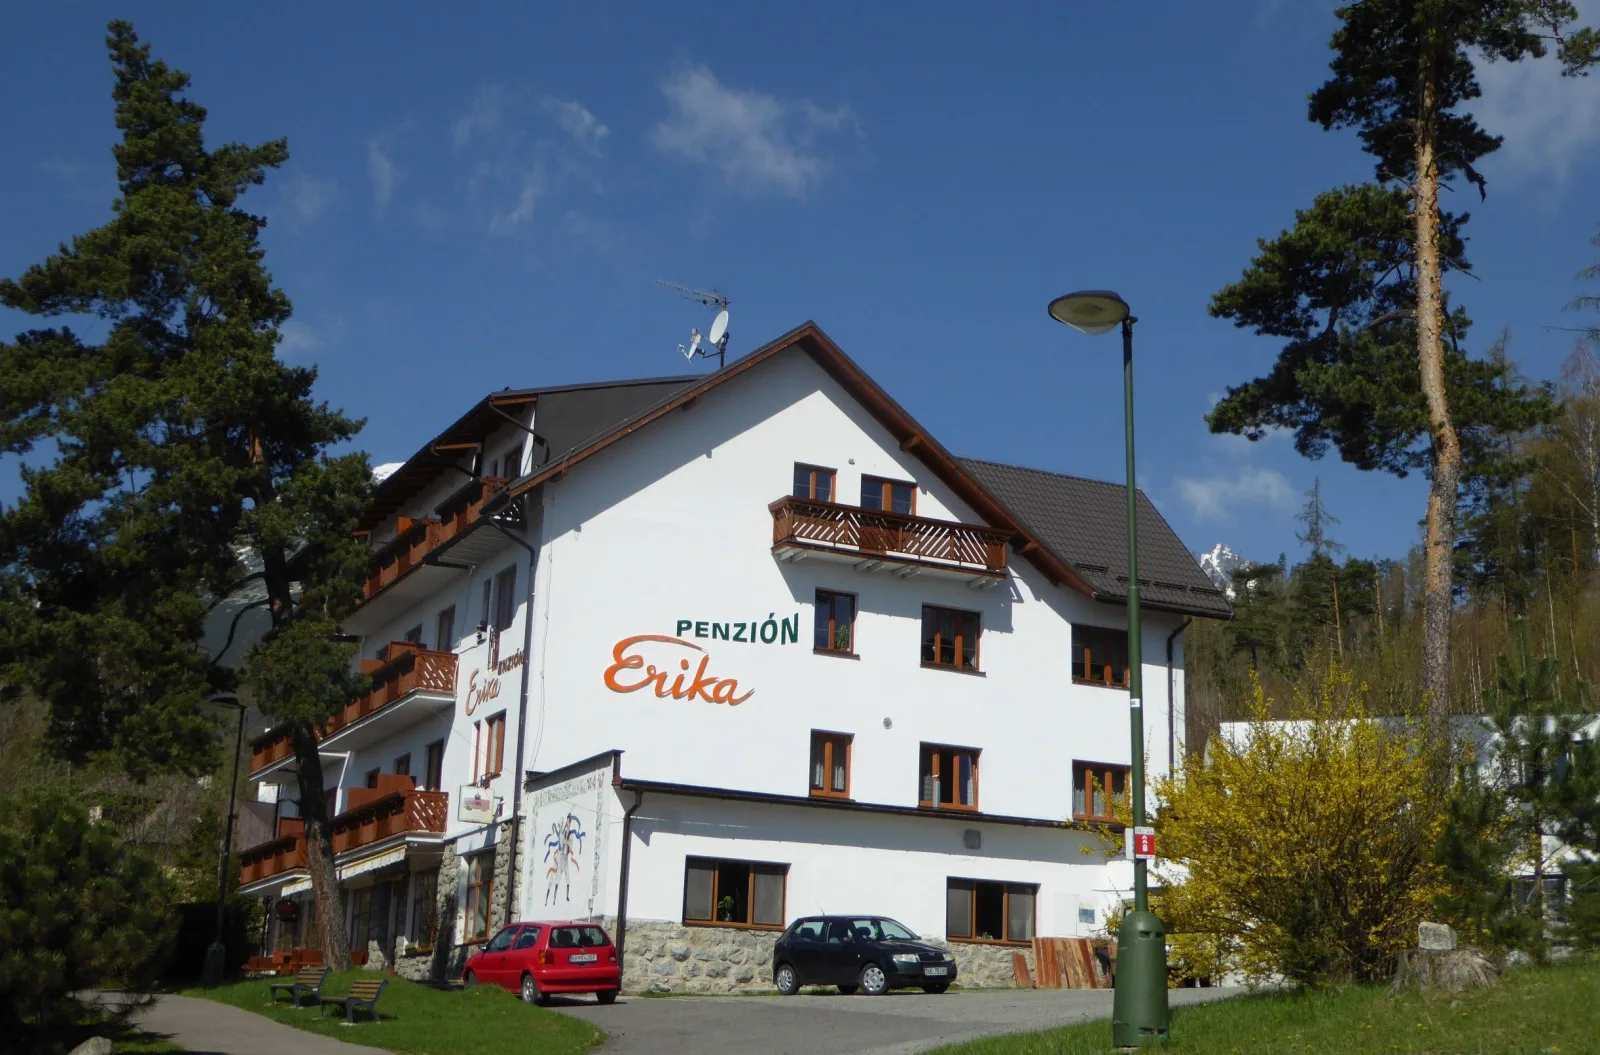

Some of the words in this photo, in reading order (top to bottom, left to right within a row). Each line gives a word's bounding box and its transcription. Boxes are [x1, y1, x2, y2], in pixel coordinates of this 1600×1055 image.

[676, 612, 799, 646] PENZIÓN
[465, 668, 502, 717] Erika
[603, 634, 756, 707] Erika
